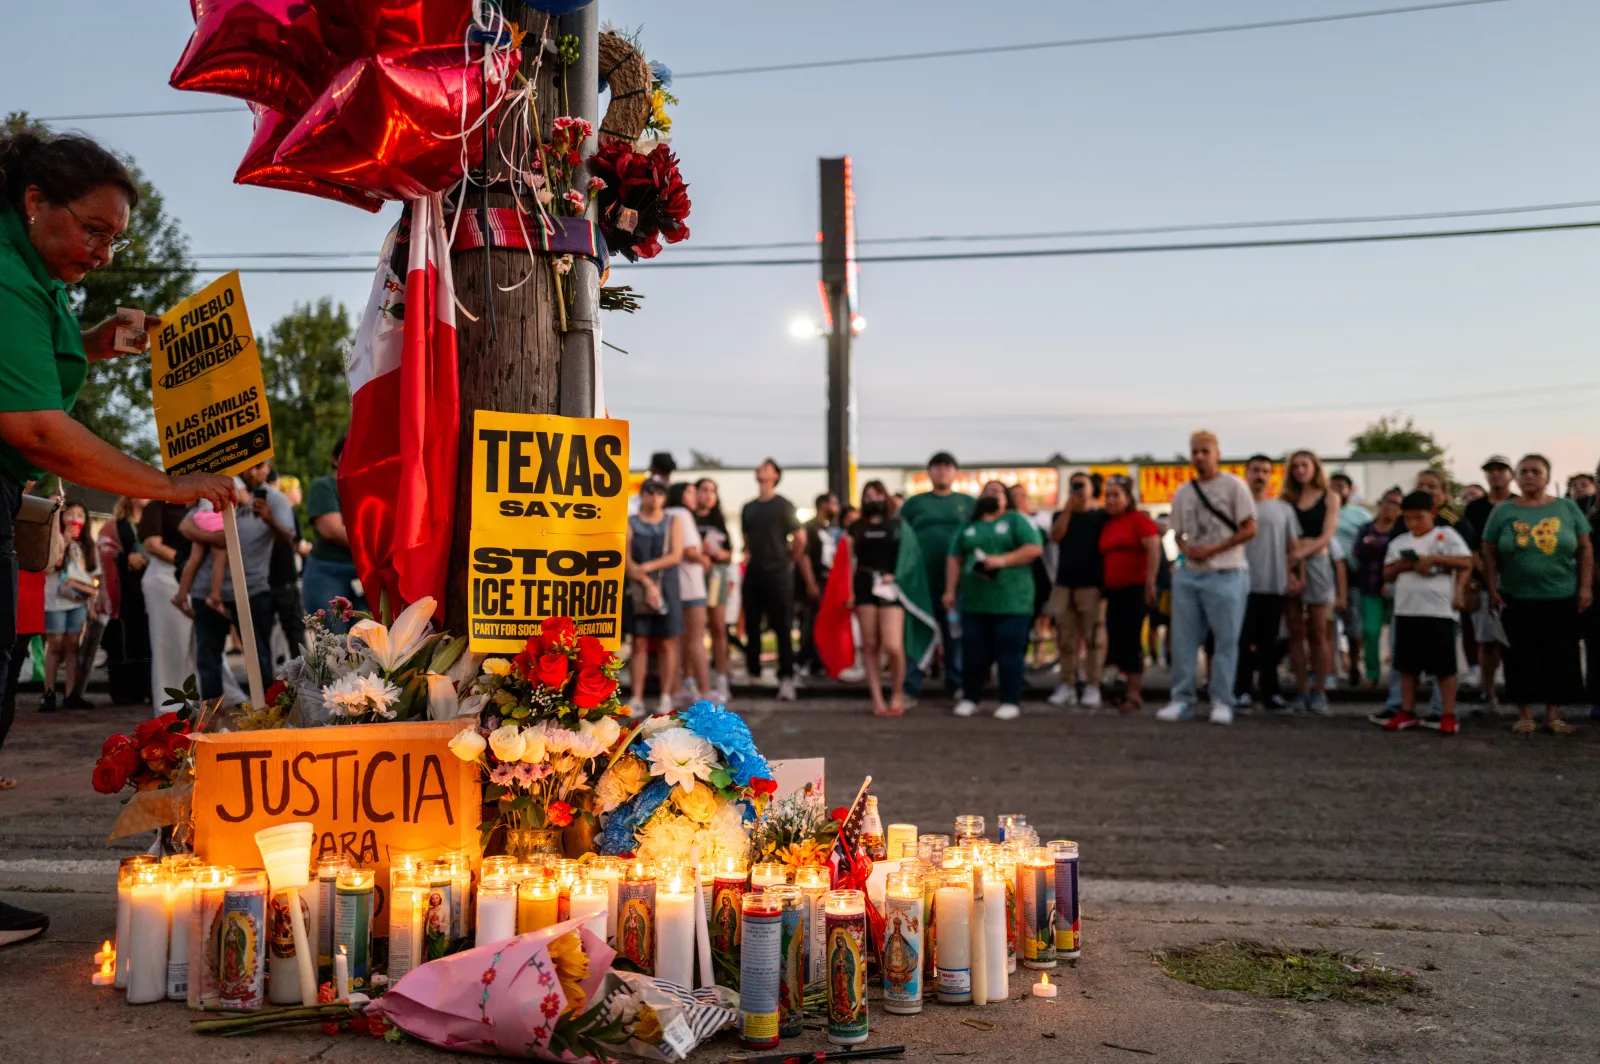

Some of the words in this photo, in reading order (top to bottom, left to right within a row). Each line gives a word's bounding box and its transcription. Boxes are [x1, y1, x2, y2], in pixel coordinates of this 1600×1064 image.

[159, 323, 179, 351] ¡EL
[180, 288, 235, 333] PUEBLO
[166, 312, 233, 369] UNIDO
[165, 334, 243, 390] DEFENDERÁ
[165, 425, 174, 440] A
[176, 413, 200, 433] LAS
[201, 386, 258, 423] FAMILIAS
[167, 403, 260, 458] MIGRANTES!
[187, 462, 196, 471] for
[197, 448, 225, 466] Socialism
[225, 442, 239, 453] and
[478, 429, 622, 498] TEXAS
[499, 500, 601, 520] SAYS:
[473, 547, 622, 577] STOP
[472, 578, 515, 616] ICE
[520, 579, 618, 617] TERROR
[474, 622, 500, 636] PARTY
[500, 624, 517, 637] FOR
[518, 623, 543, 636] SOCIA
[578, 622, 613, 635] BERATION
[216, 750, 454, 825] JUSTICIA
